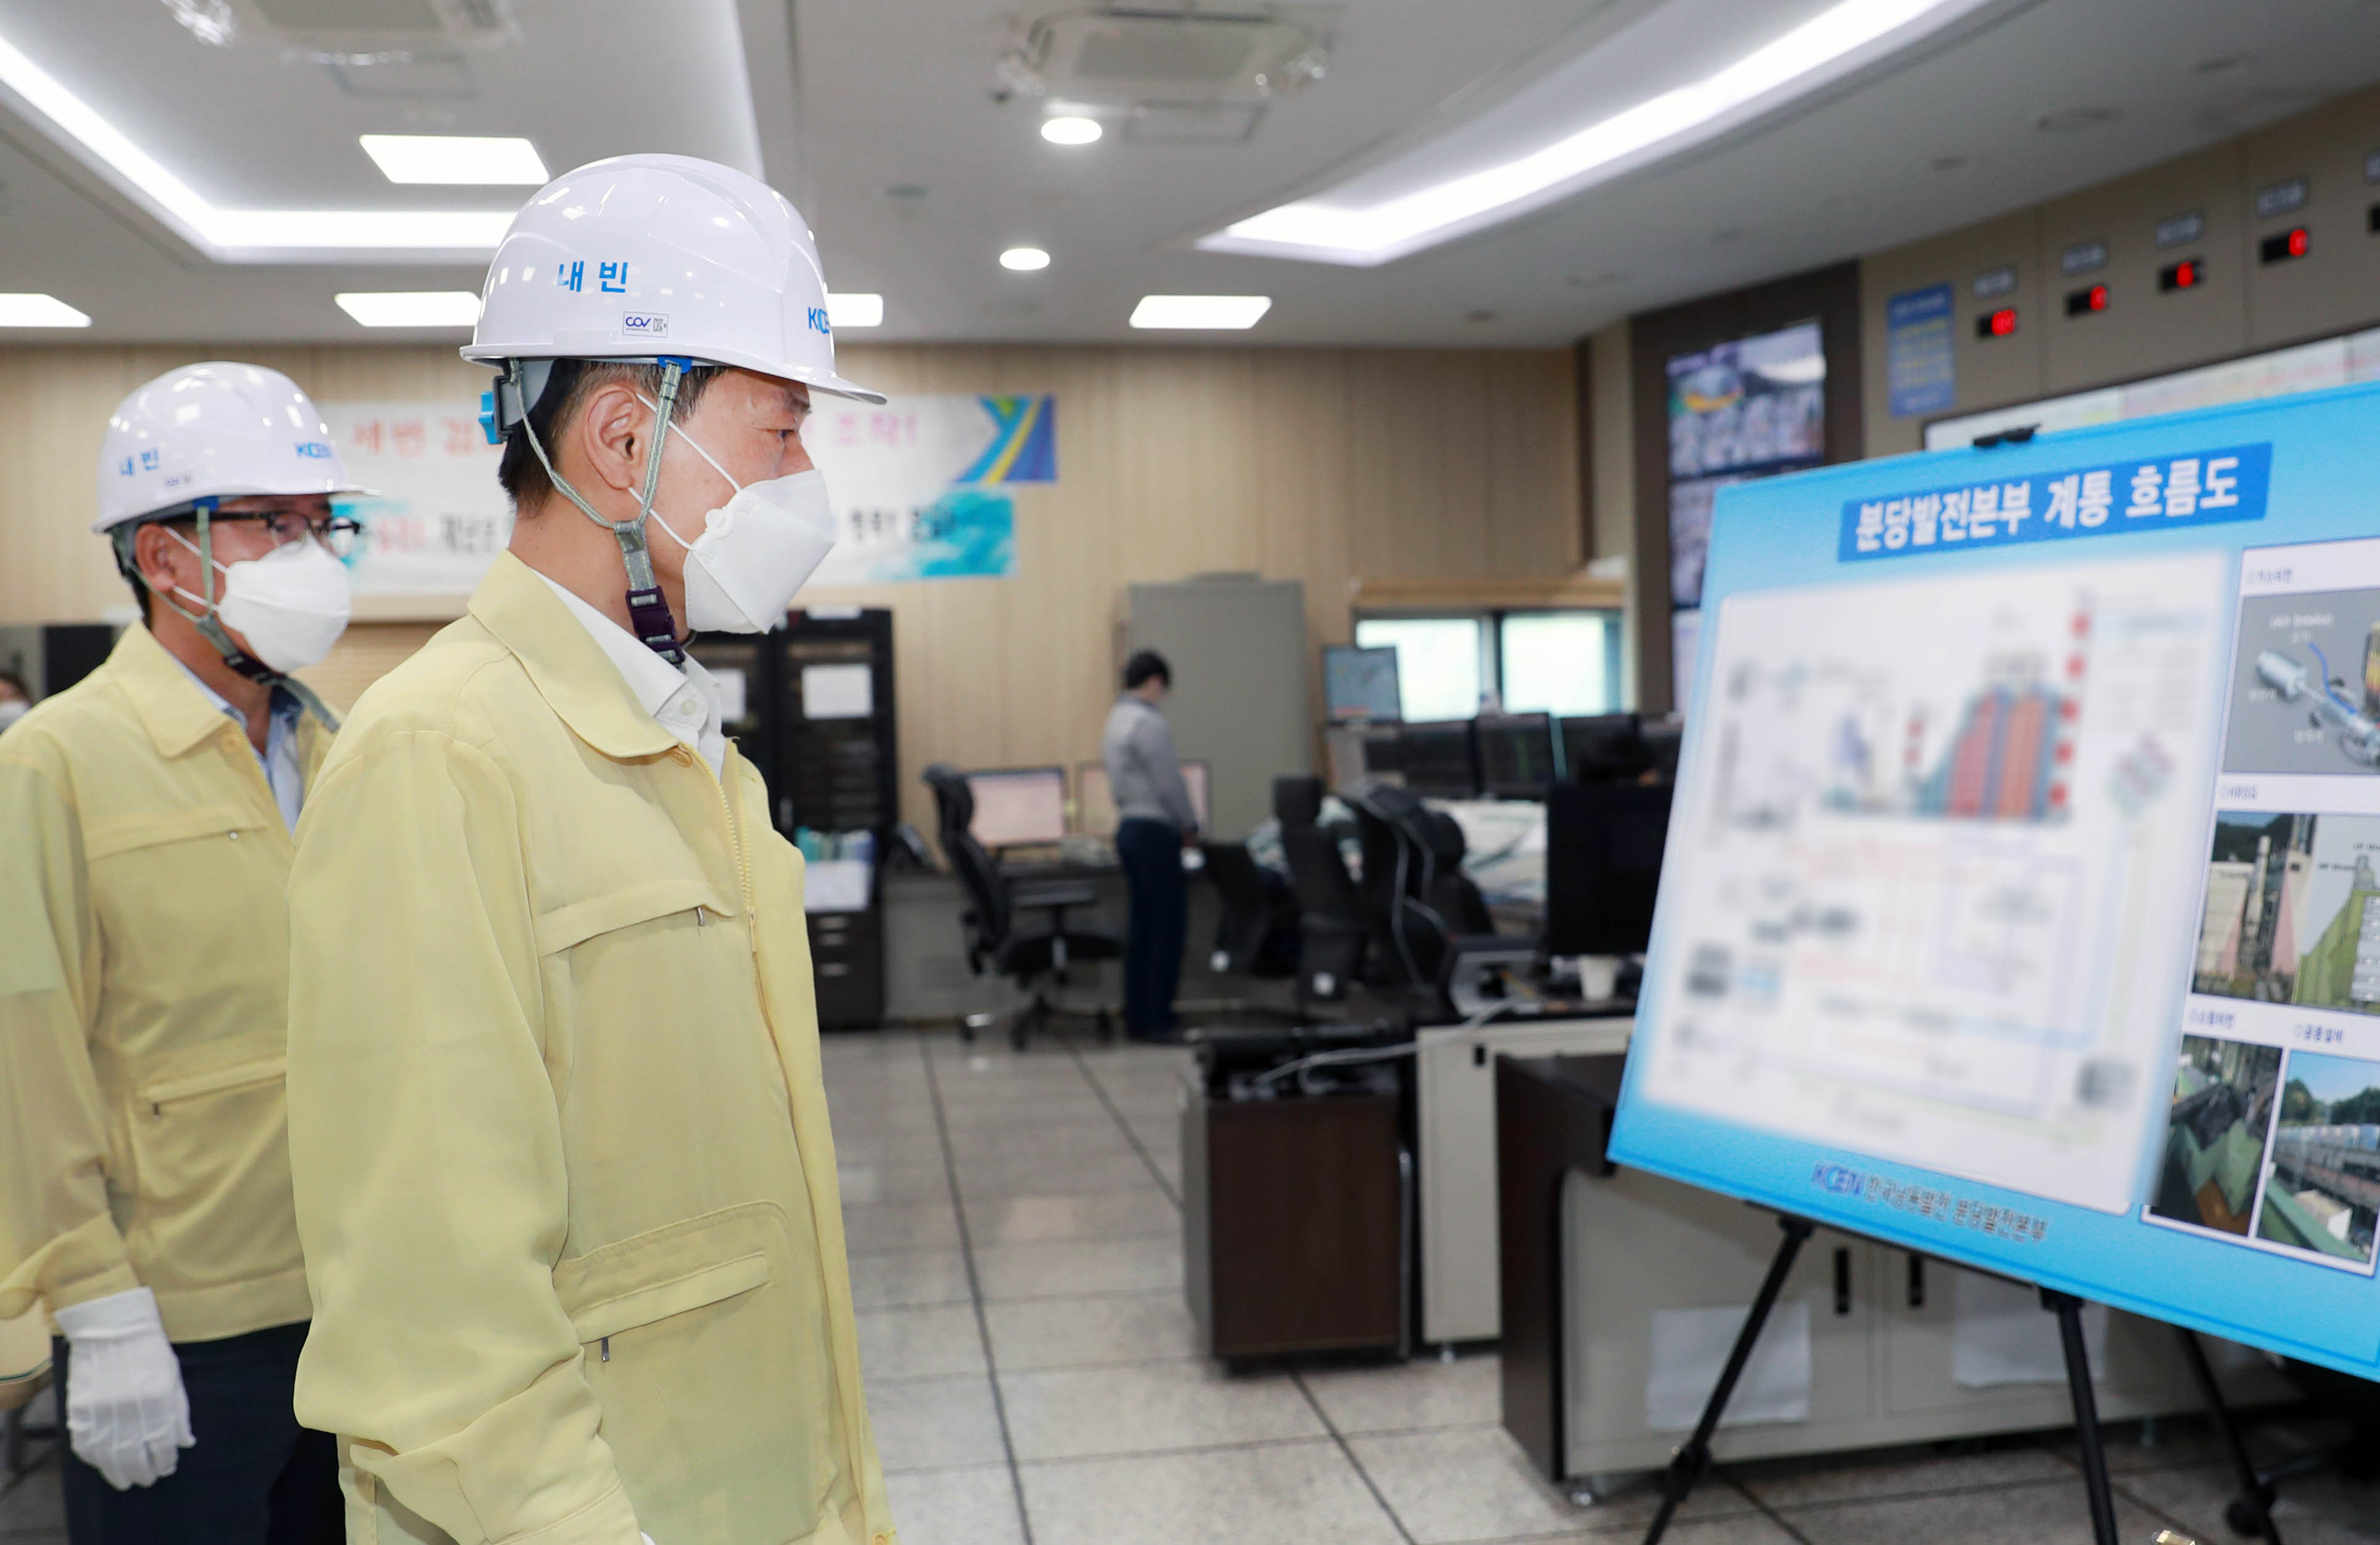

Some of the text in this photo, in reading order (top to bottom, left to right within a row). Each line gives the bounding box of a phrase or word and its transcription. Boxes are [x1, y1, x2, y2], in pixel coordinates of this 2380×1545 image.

[1855, 457, 2239, 552] 분당발전본부 계통 흐름도
